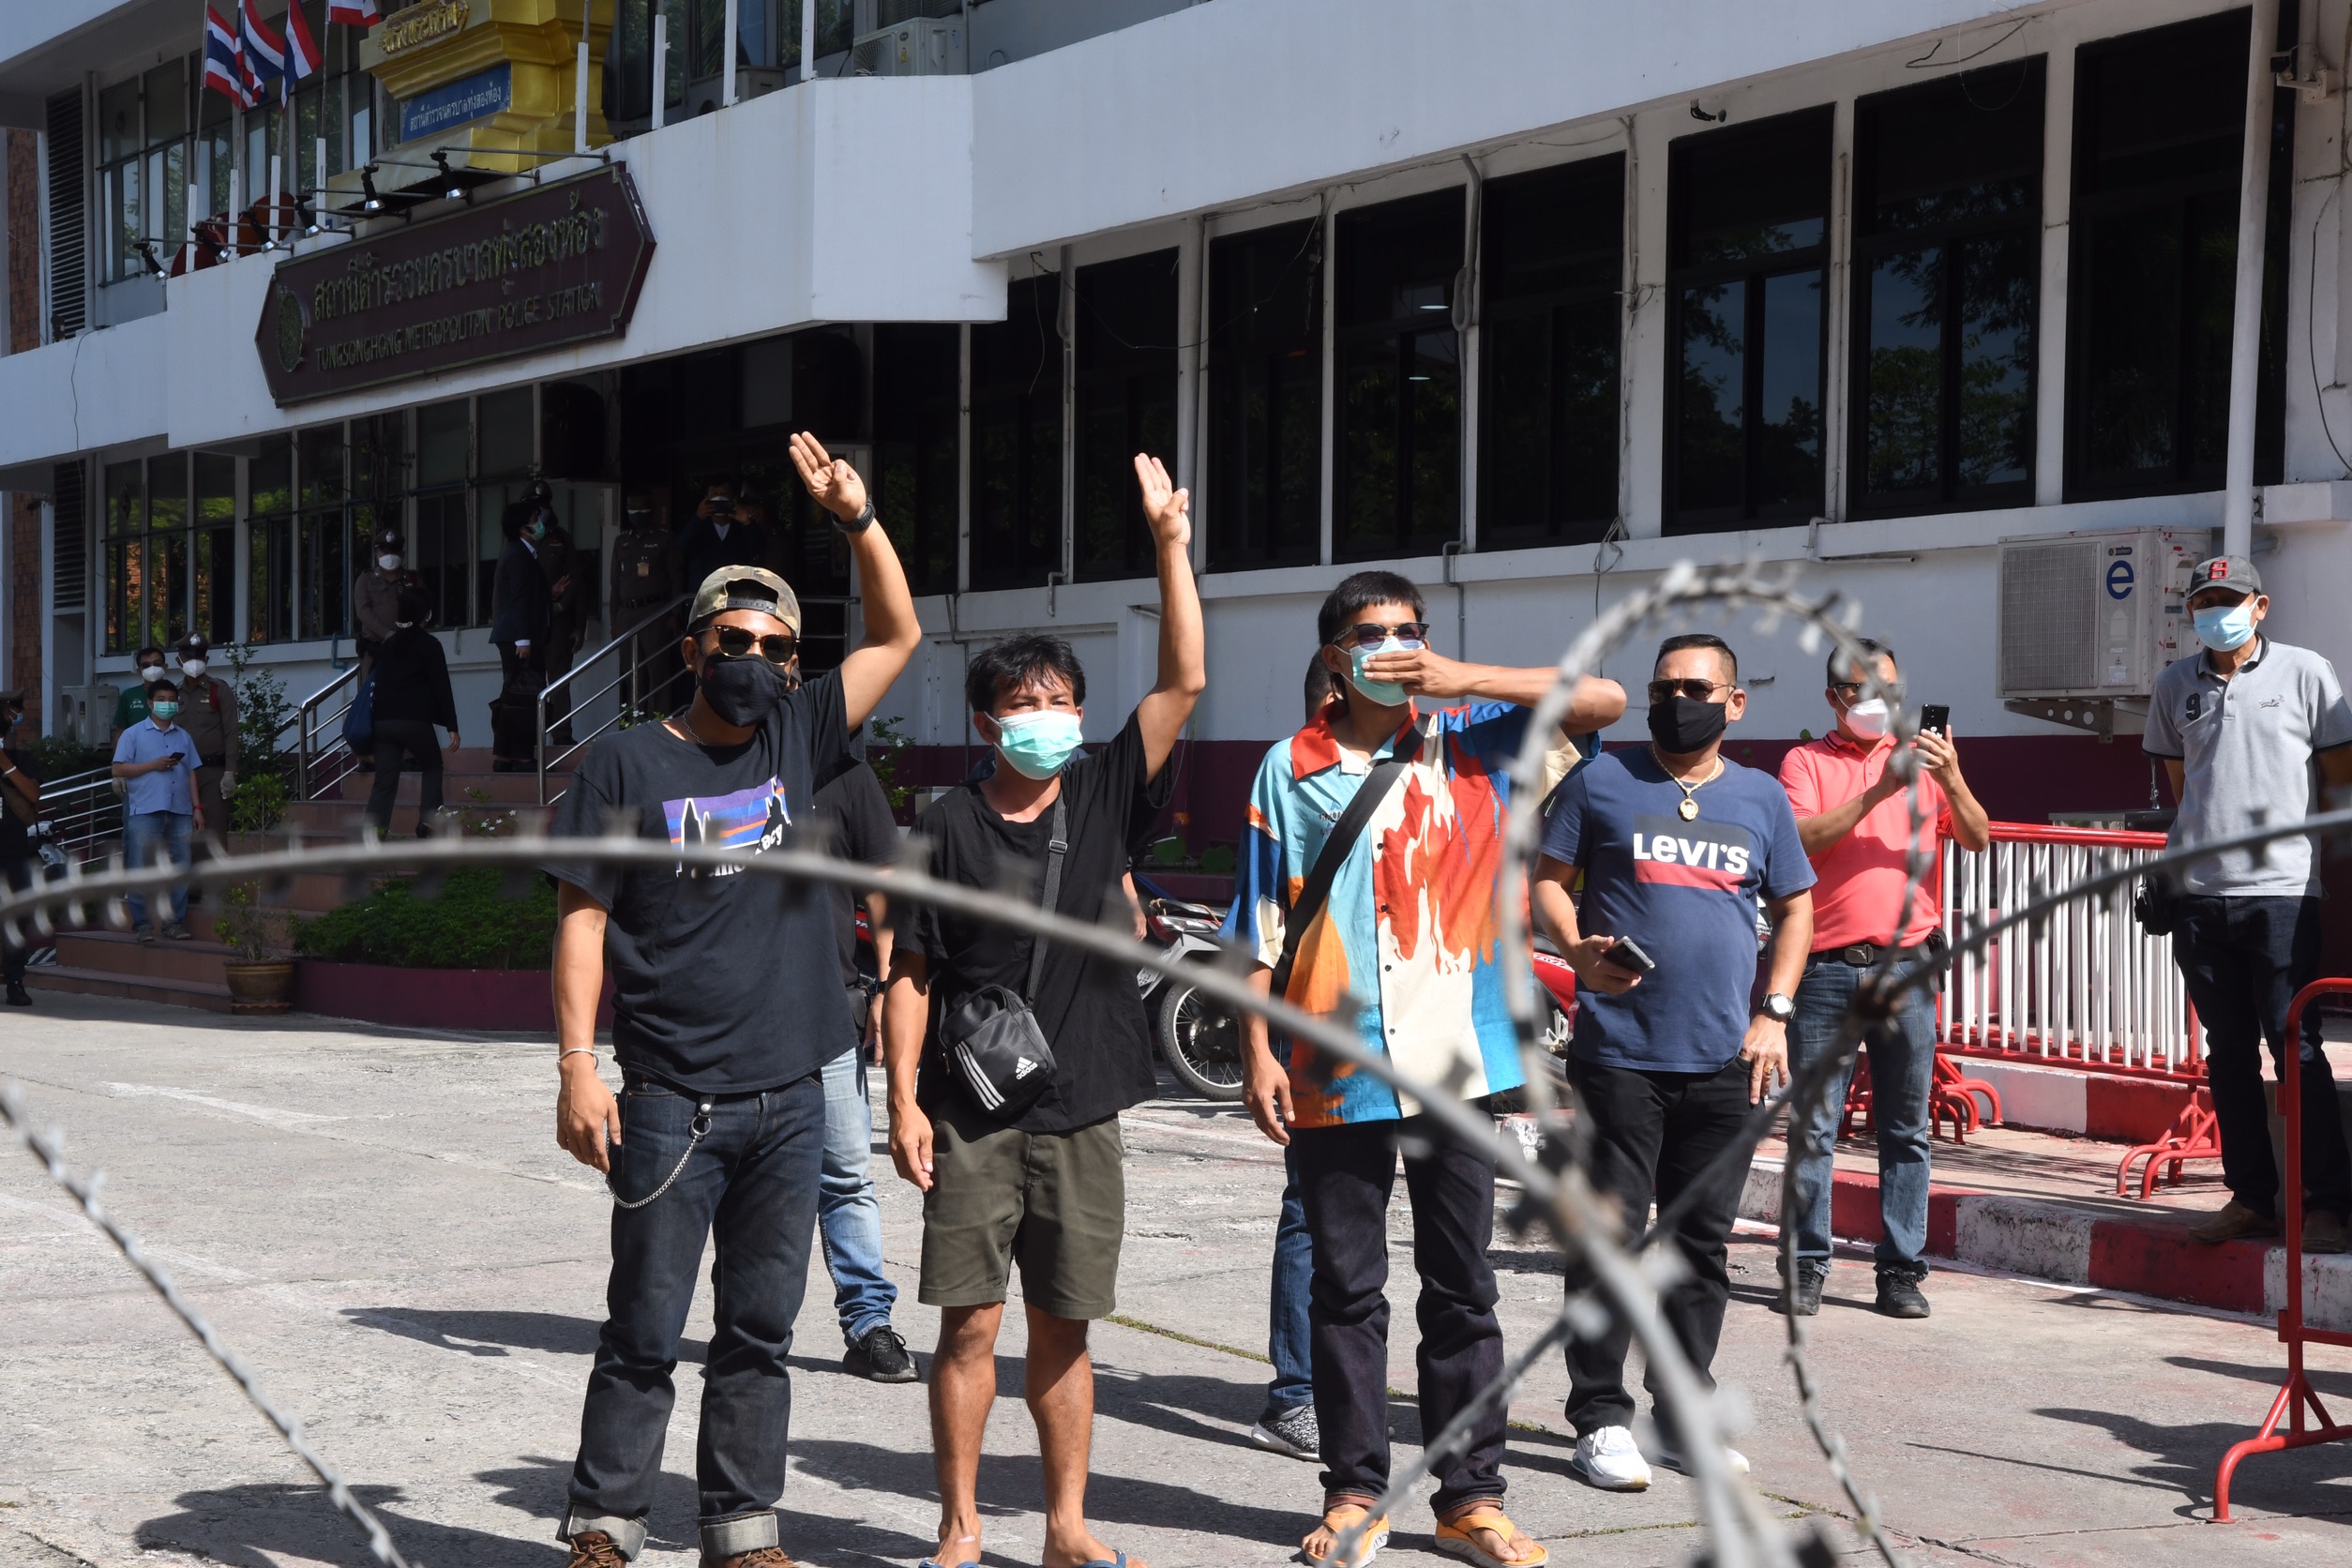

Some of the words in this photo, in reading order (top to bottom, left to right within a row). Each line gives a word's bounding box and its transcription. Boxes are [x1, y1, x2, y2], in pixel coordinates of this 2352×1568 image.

[315, 329, 401, 371] TUNGSONGHONG
[405, 308, 491, 351] METROPOLITAN
[498, 295, 541, 330] POLICE
[547, 282, 602, 321] STATION
[2186, 692, 2201, 721] 9
[1016, 1062, 1038, 1080] adidas
